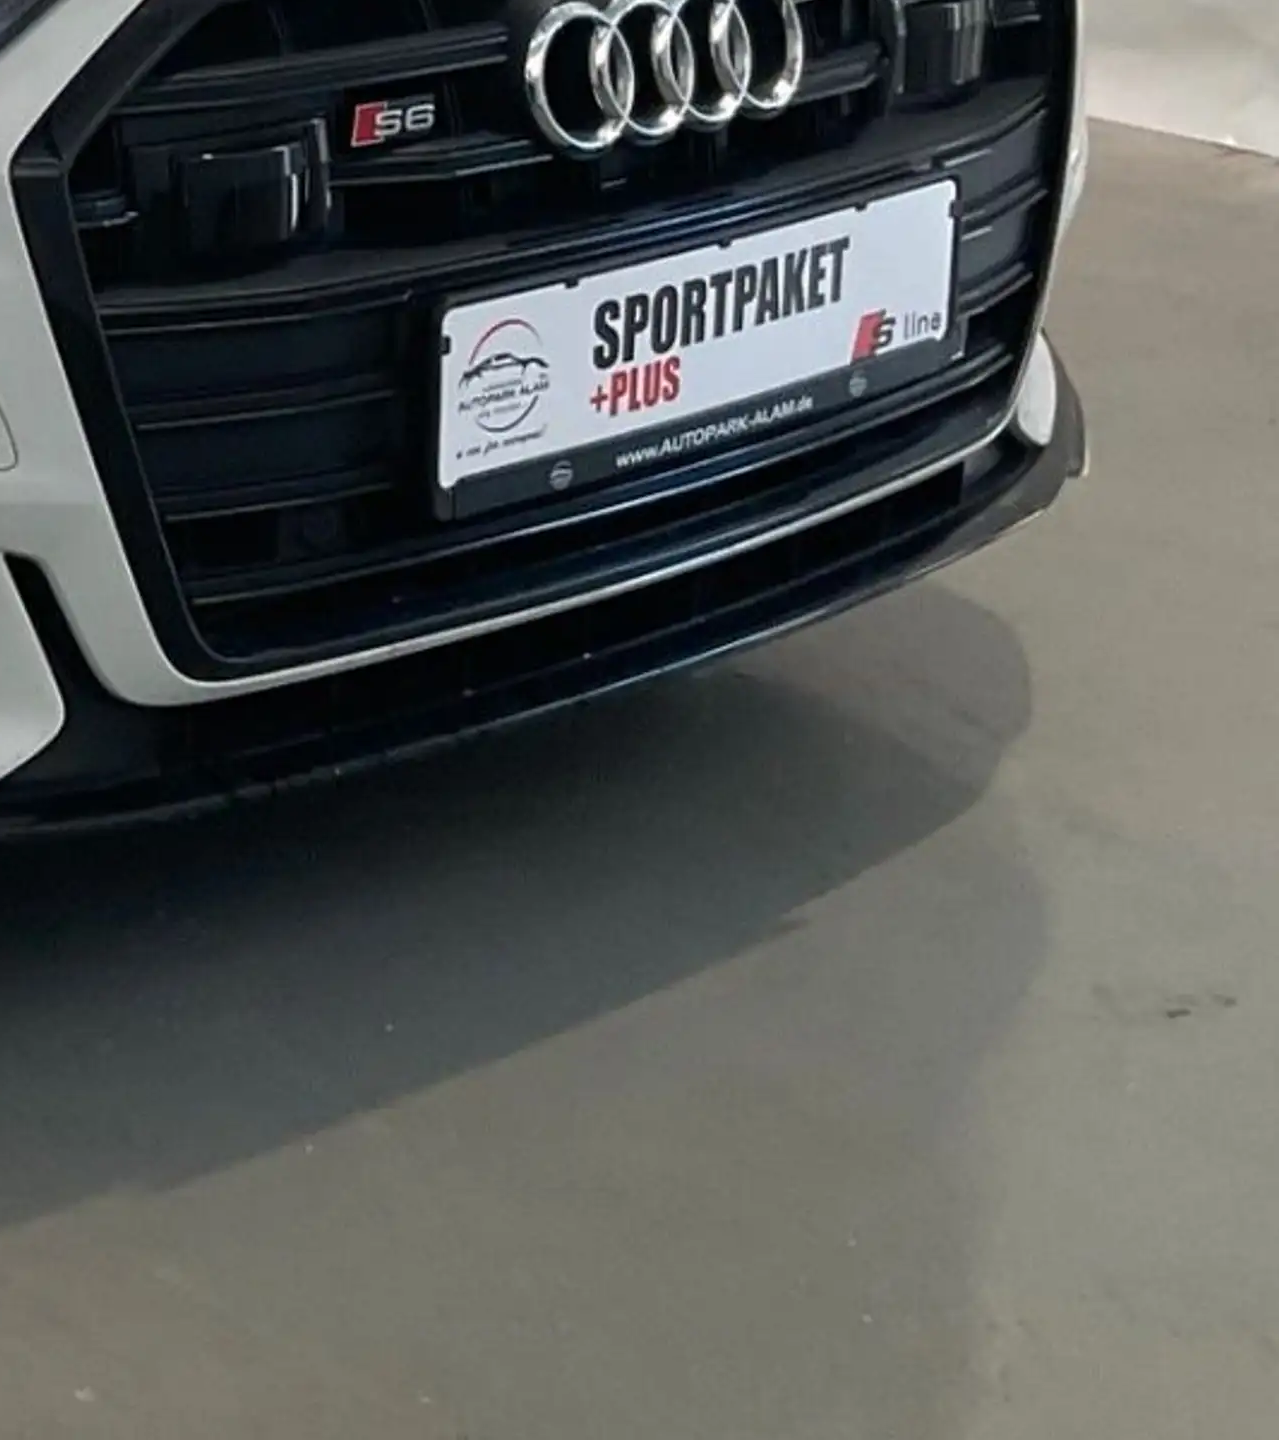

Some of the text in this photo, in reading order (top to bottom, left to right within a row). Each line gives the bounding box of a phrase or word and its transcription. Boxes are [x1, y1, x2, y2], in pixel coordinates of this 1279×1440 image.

[373, 103, 435, 137] S6
[593, 236, 850, 369] SPORTPAKET
[902, 310, 943, 340] line
[457, 389, 516, 414] AUTOPARK
[589, 356, 681, 417] +PLUS
[615, 396, 814, 468] www.AUTOPARK-ALAM.de
